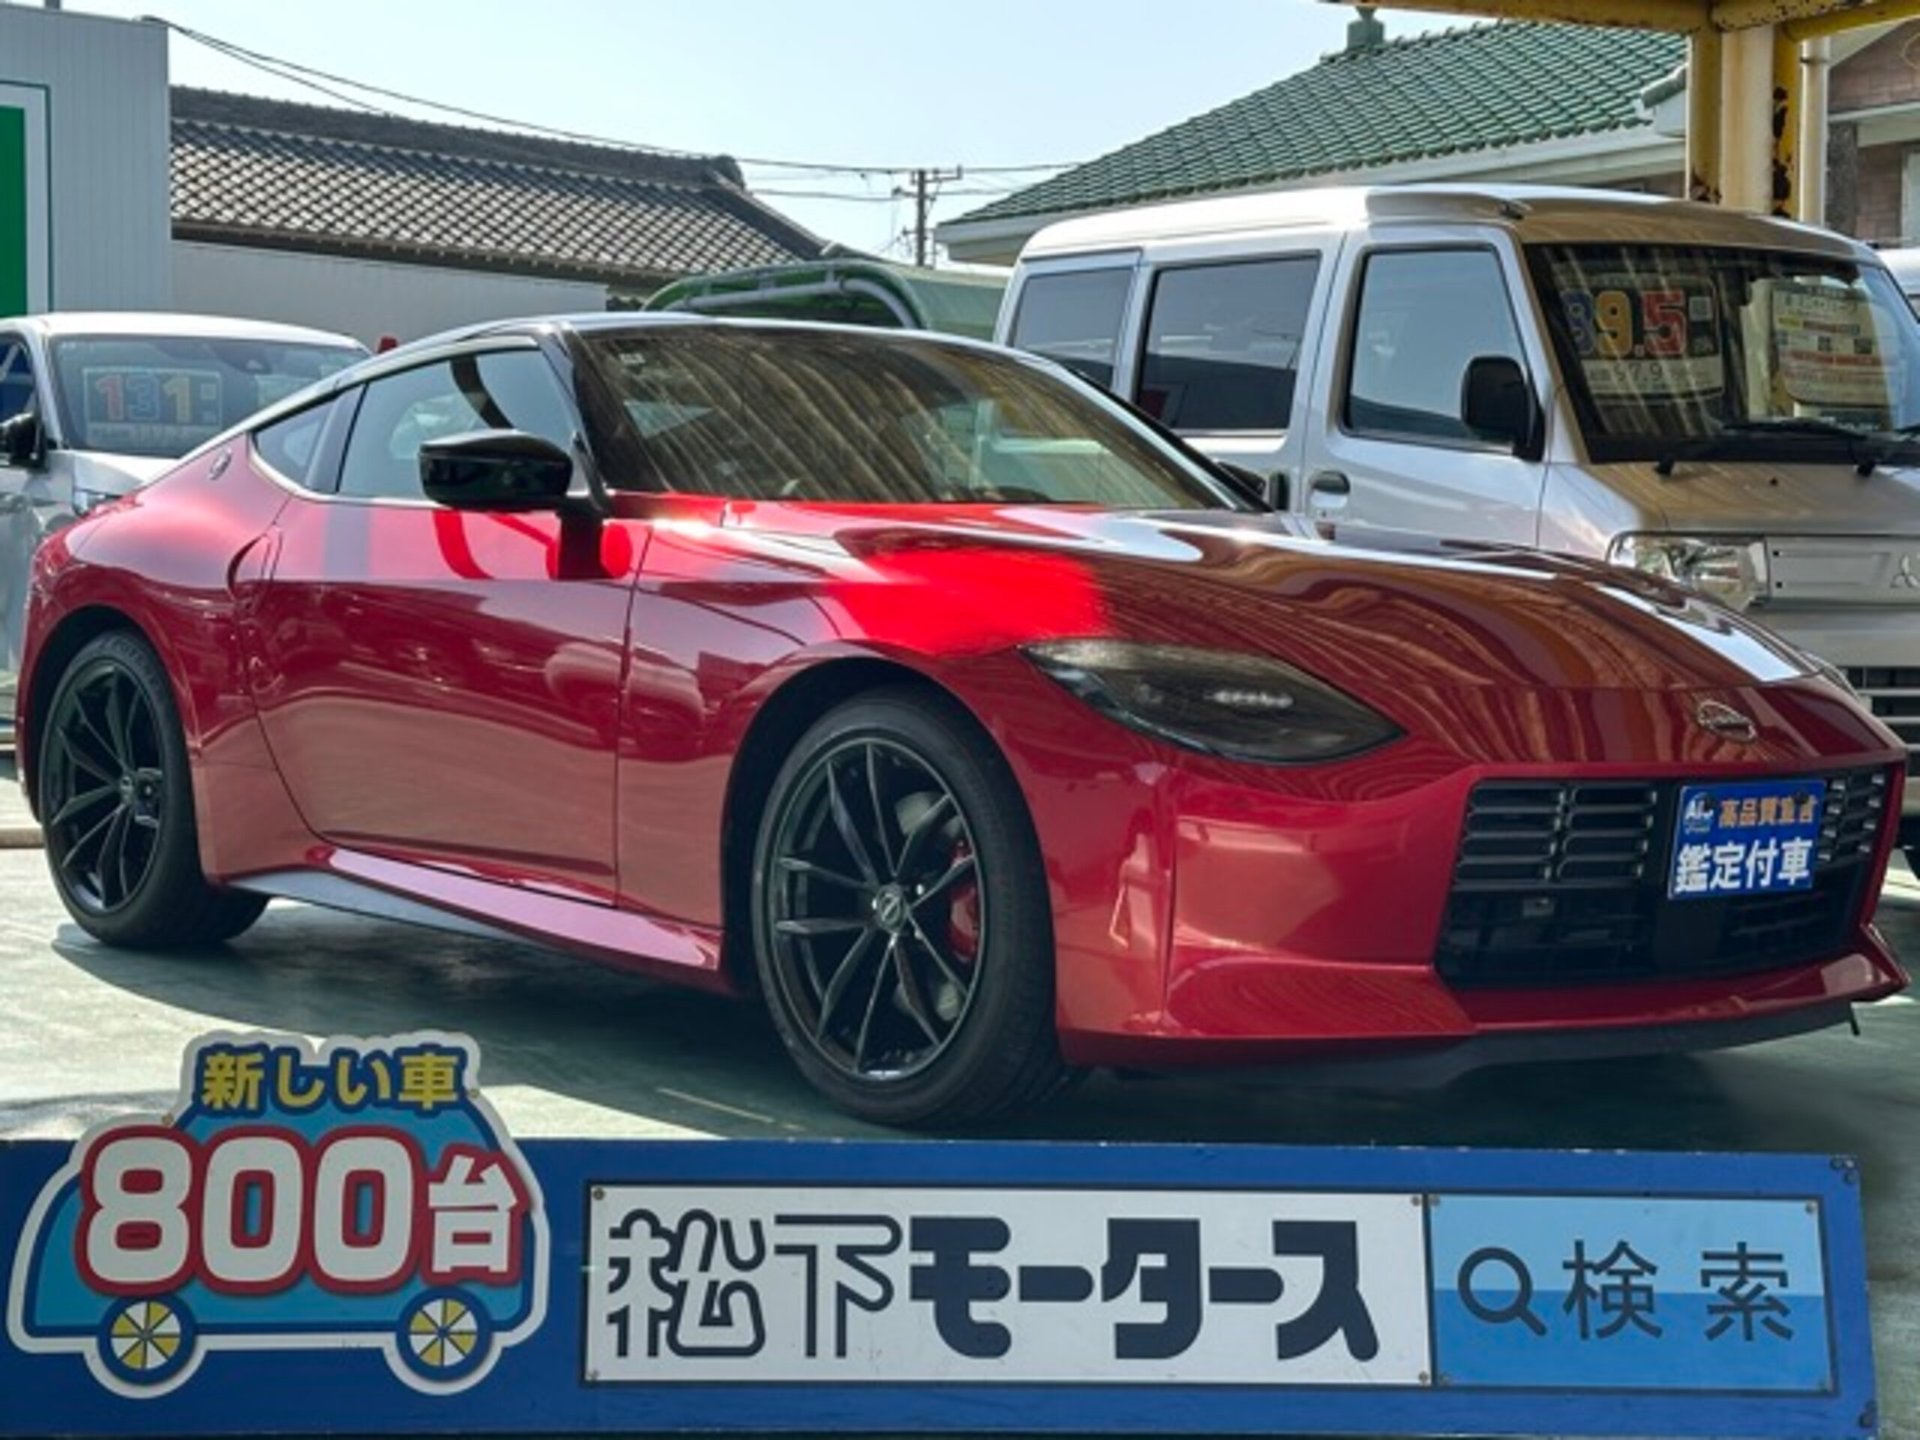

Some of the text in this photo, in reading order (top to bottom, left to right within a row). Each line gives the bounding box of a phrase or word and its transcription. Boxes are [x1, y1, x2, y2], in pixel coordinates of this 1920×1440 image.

[1674, 837, 1813, 894] 鑑定付車
[202, 1051, 461, 1111] 新しい車
[85, 1134, 519, 1284] 800台
[606, 1208, 1381, 1362] 松下モータース
[1562, 1239, 1795, 1342] 検索
